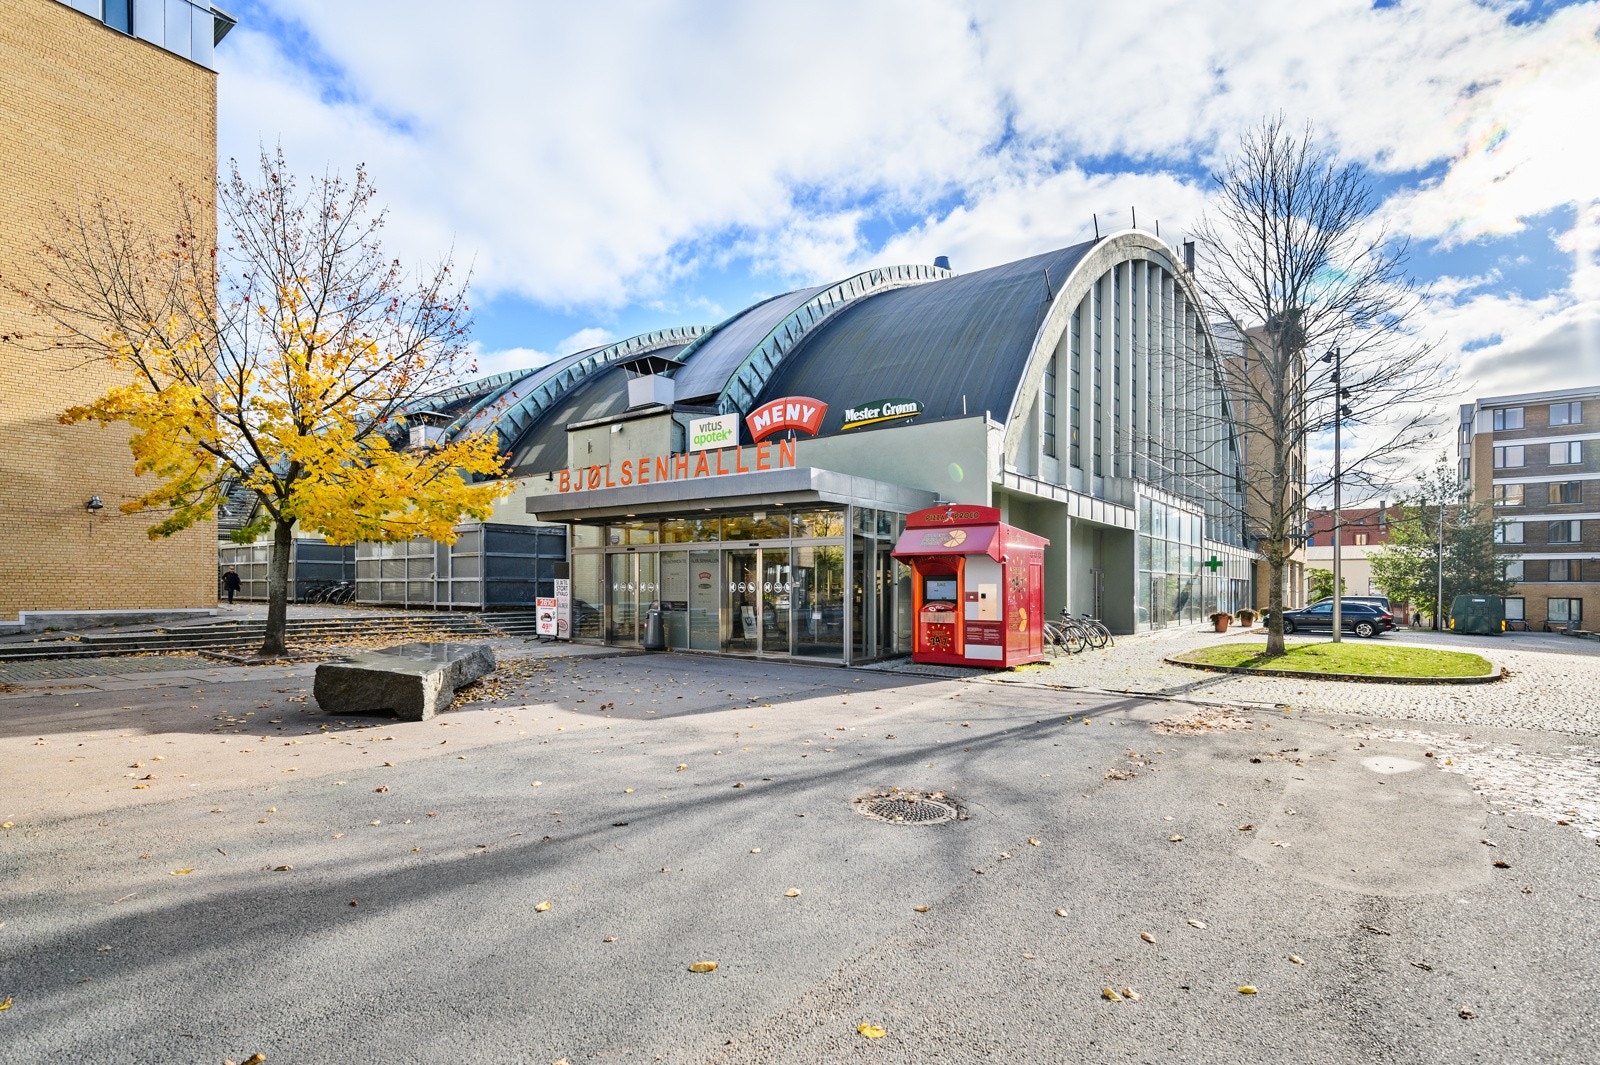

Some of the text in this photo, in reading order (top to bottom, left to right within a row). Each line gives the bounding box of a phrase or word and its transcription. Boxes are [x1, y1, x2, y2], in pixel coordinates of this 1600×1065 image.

[753, 403, 816, 431] MENY
[845, 402, 917, 423] Mester Grønn
[699, 421, 722, 433] vitus
[559, 438, 796, 493] BJØLSENHALLEN
